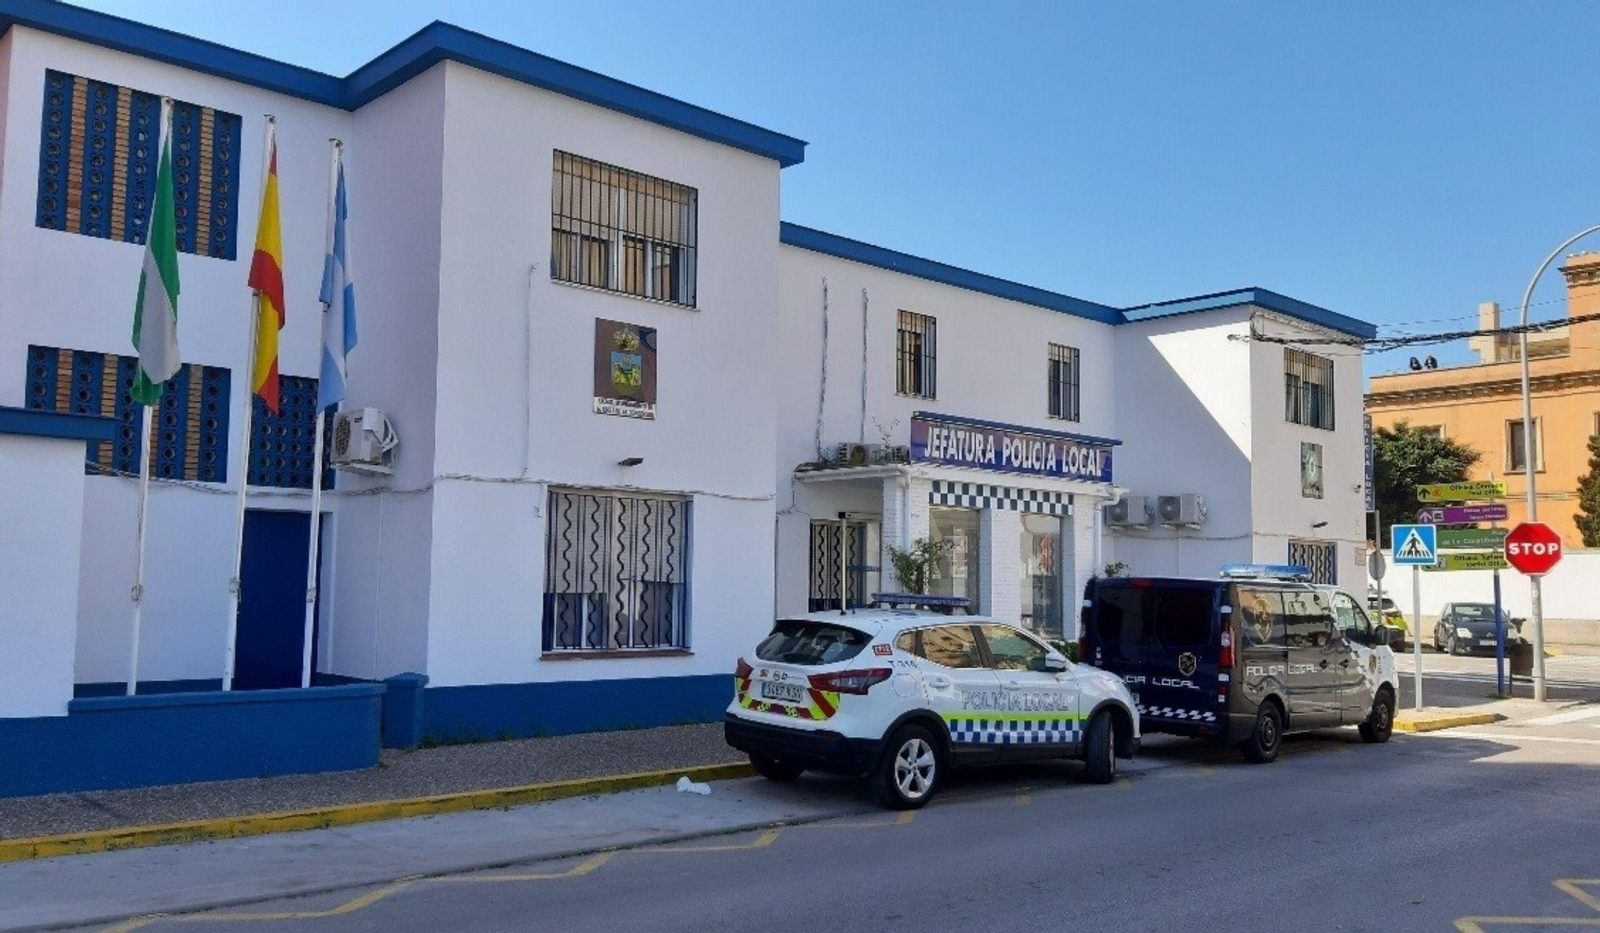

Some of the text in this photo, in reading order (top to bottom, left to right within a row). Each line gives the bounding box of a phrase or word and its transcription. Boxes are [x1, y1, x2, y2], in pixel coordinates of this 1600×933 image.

[924, 427, 1102, 477] JEFATURA POLICIA LOCAL
[1509, 542, 1558, 555] STOP
[1152, 677, 1200, 689] LOCAL
[961, 690, 1069, 712] POLICIA LOCAL
